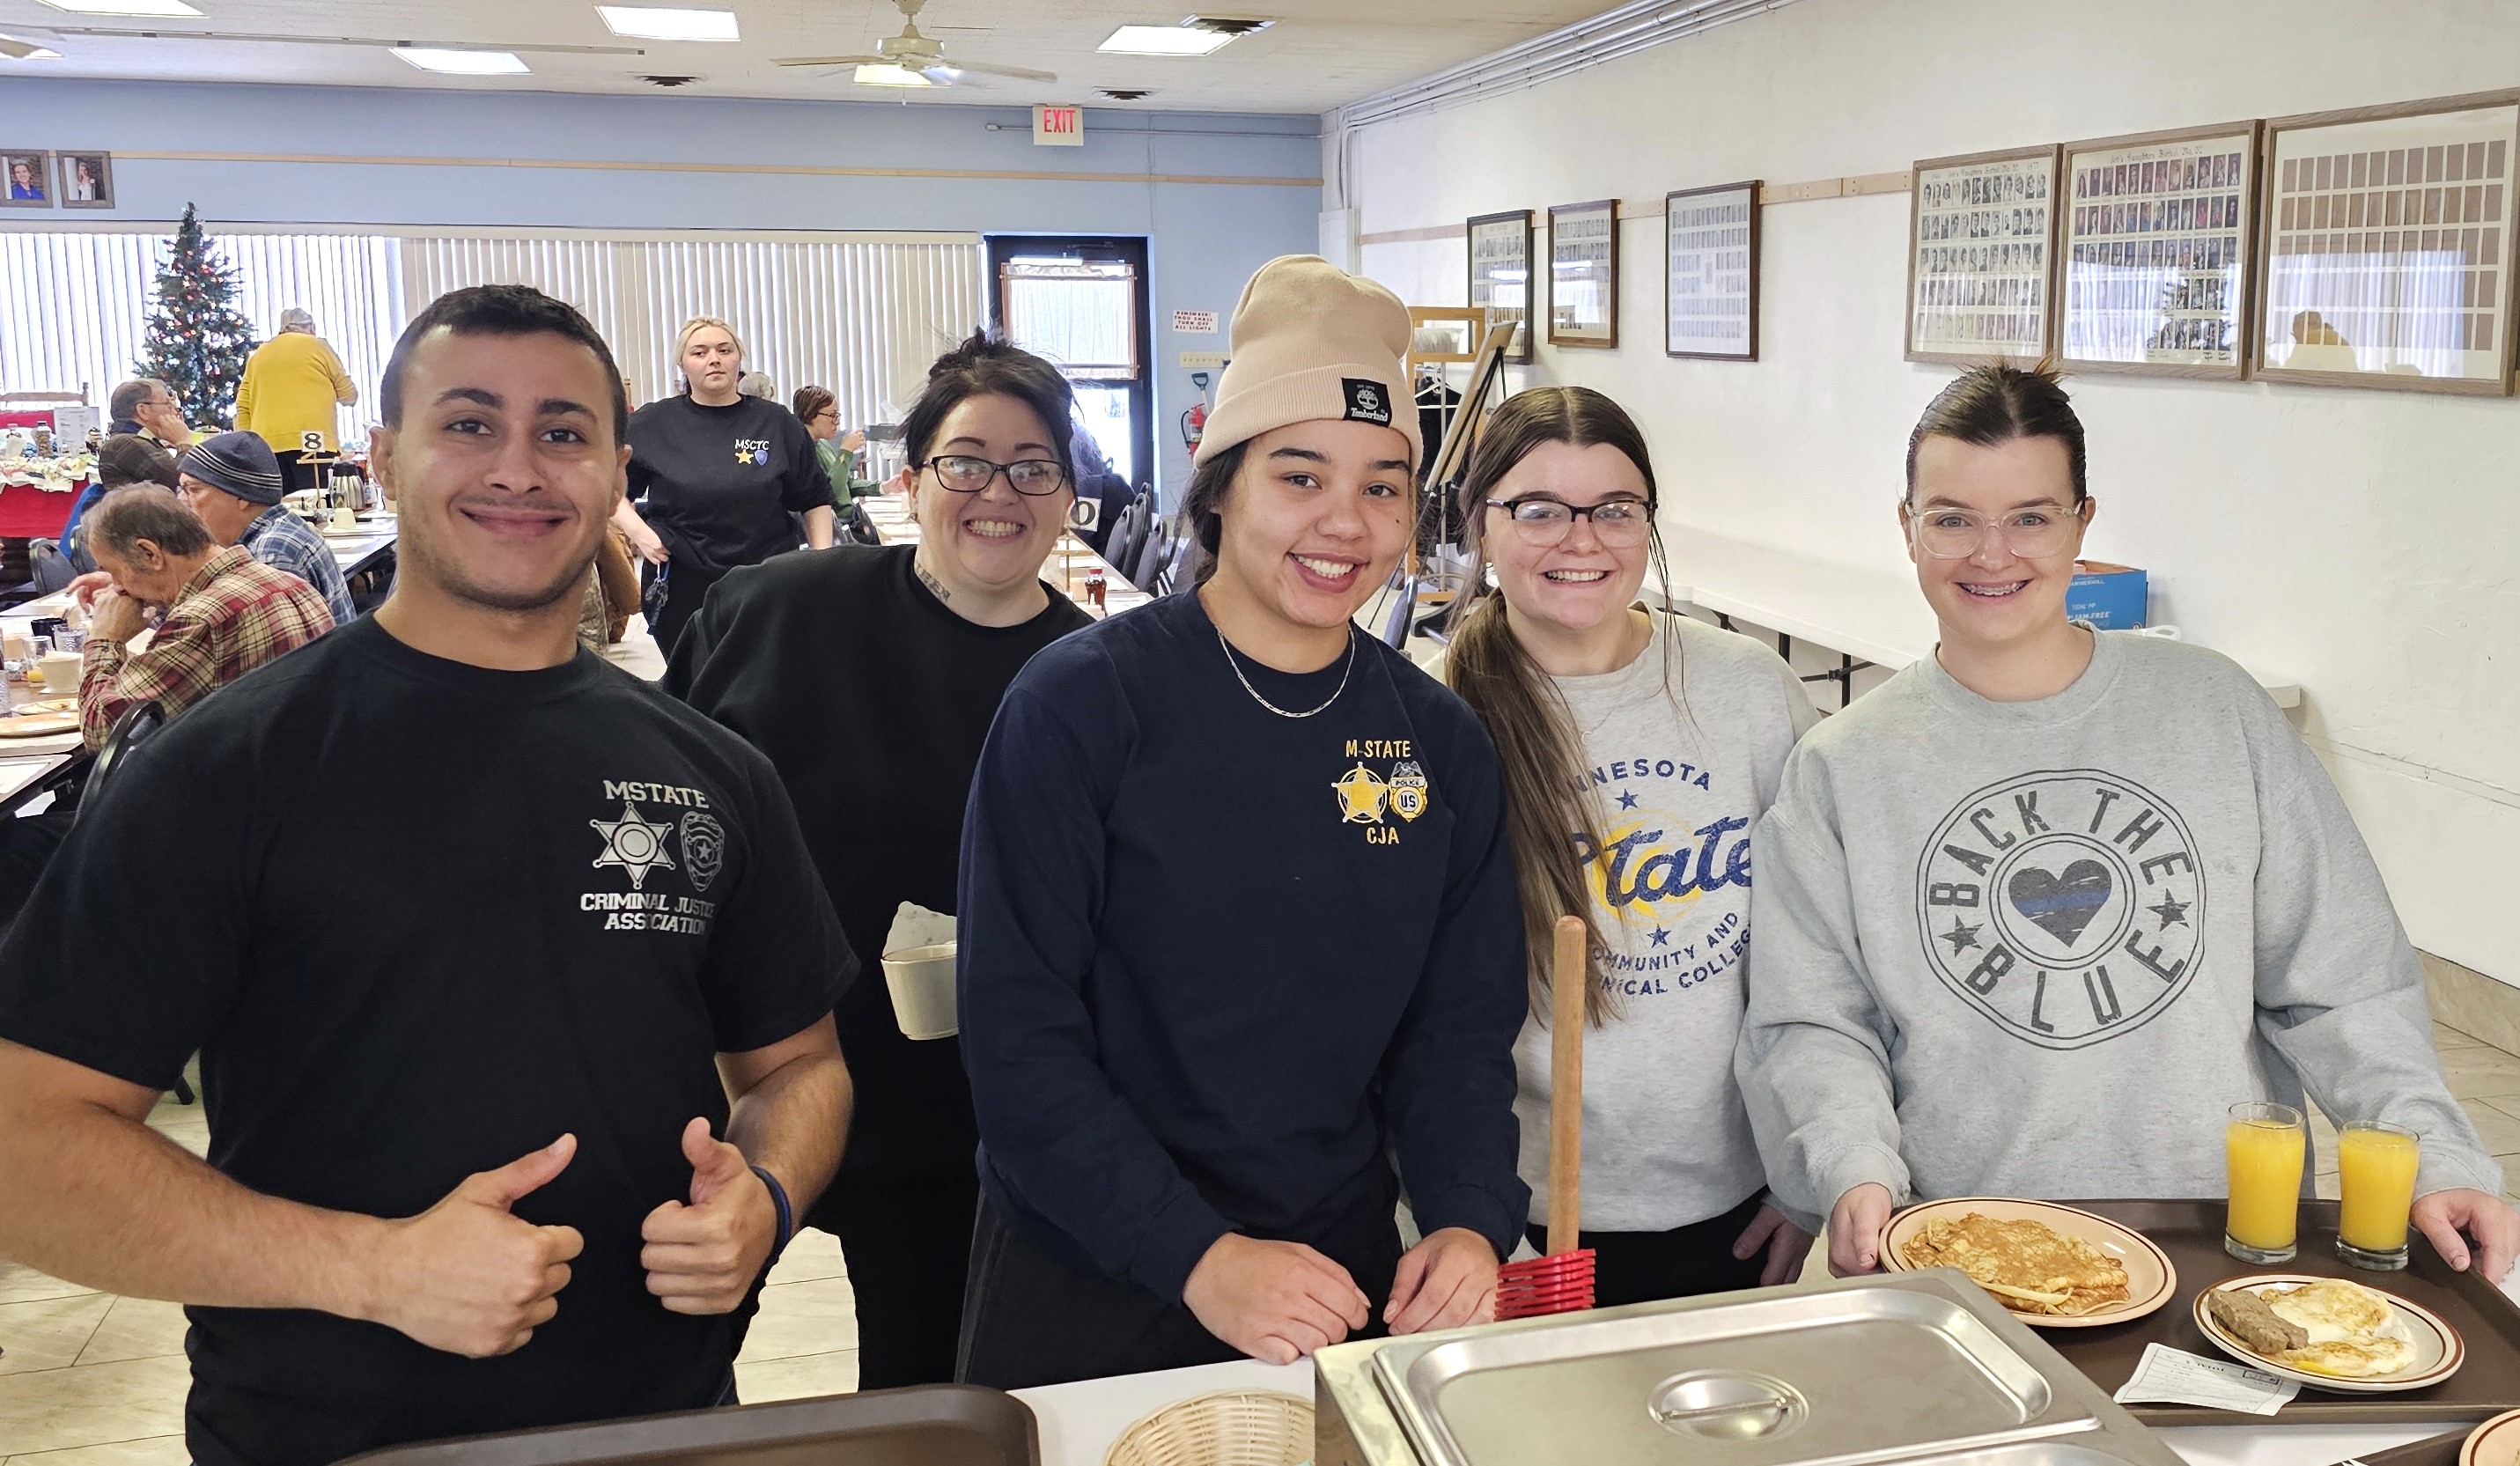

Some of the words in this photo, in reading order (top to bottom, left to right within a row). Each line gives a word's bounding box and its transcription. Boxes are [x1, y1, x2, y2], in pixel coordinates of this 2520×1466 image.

[1043, 109, 1076, 134] EXIT
[1351, 407, 1389, 422] Timberland
[304, 432, 322, 450] 8
[734, 438, 770, 450] MSCTC
[1575, 759, 1711, 792] NESOTA
[603, 779, 710, 808] MSTATE
[1401, 794, 1417, 808] US
[1367, 827, 1400, 844] CJA
[1928, 790, 2052, 908] BACK
[2088, 787, 2193, 886] THE
[580, 892, 670, 911] CRIMINAL
[674, 896, 717, 917] JUSTI
[1592, 943, 1696, 972] OMMUNITY
[1706, 912, 1738, 949] AND
[1678, 921, 1751, 989] COLLEG
[1964, 928, 2185, 1034] BLUE
